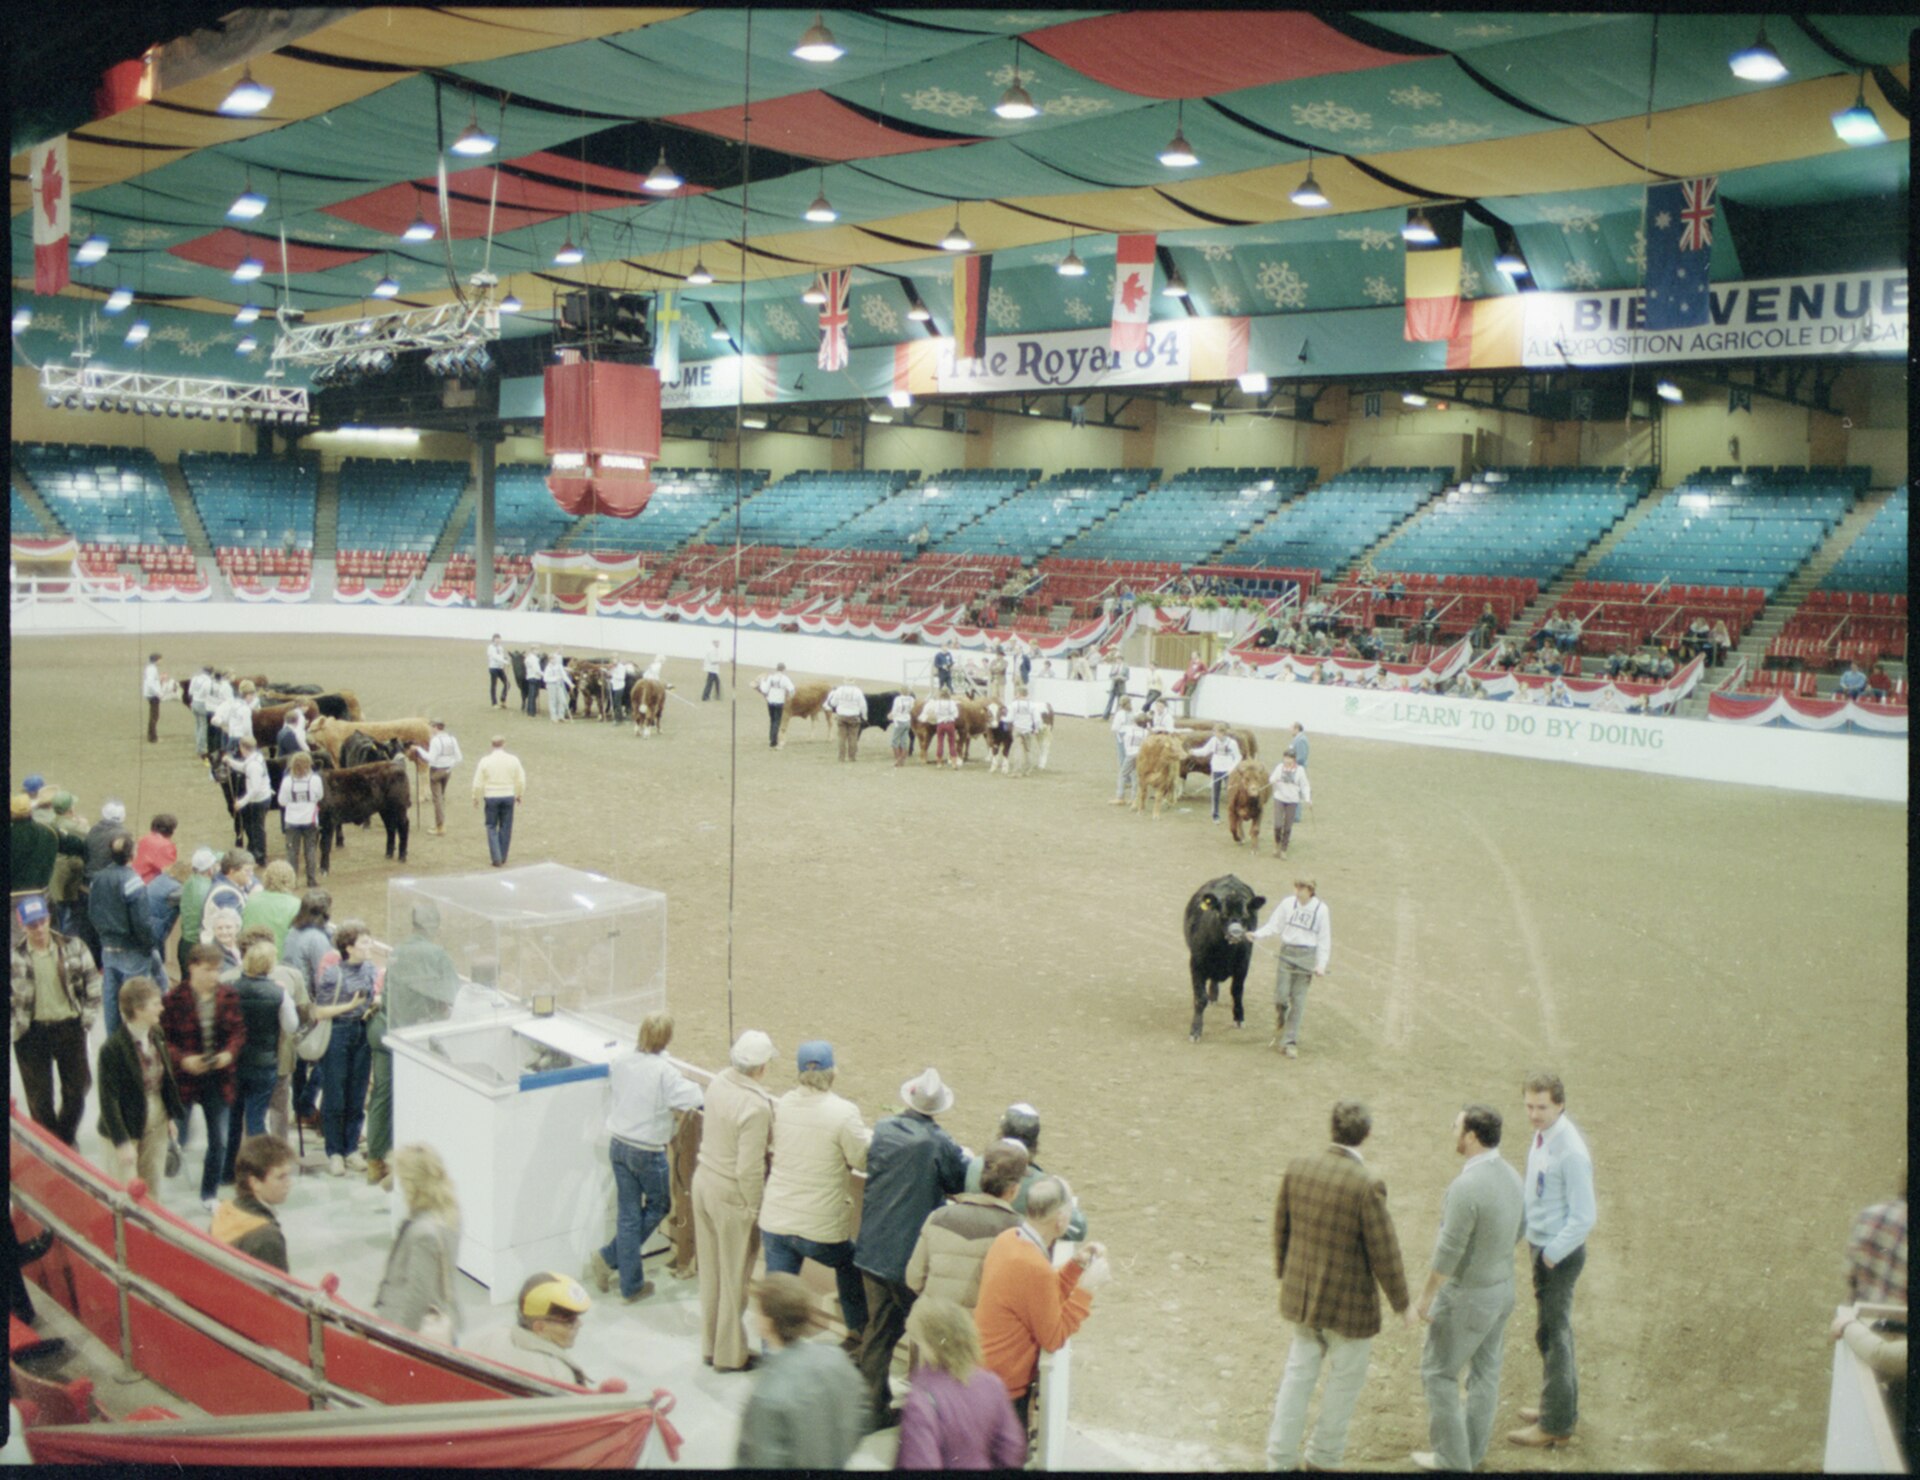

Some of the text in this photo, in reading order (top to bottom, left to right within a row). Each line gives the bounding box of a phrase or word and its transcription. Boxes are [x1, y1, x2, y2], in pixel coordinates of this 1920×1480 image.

[1574, 278, 1908, 332] BIEVENUE
[1689, 326, 1814, 352] AGRICOLE
[1820, 324, 1856, 345] DU
[1393, 703, 1665, 750] LEARN TO DO BY DOING
